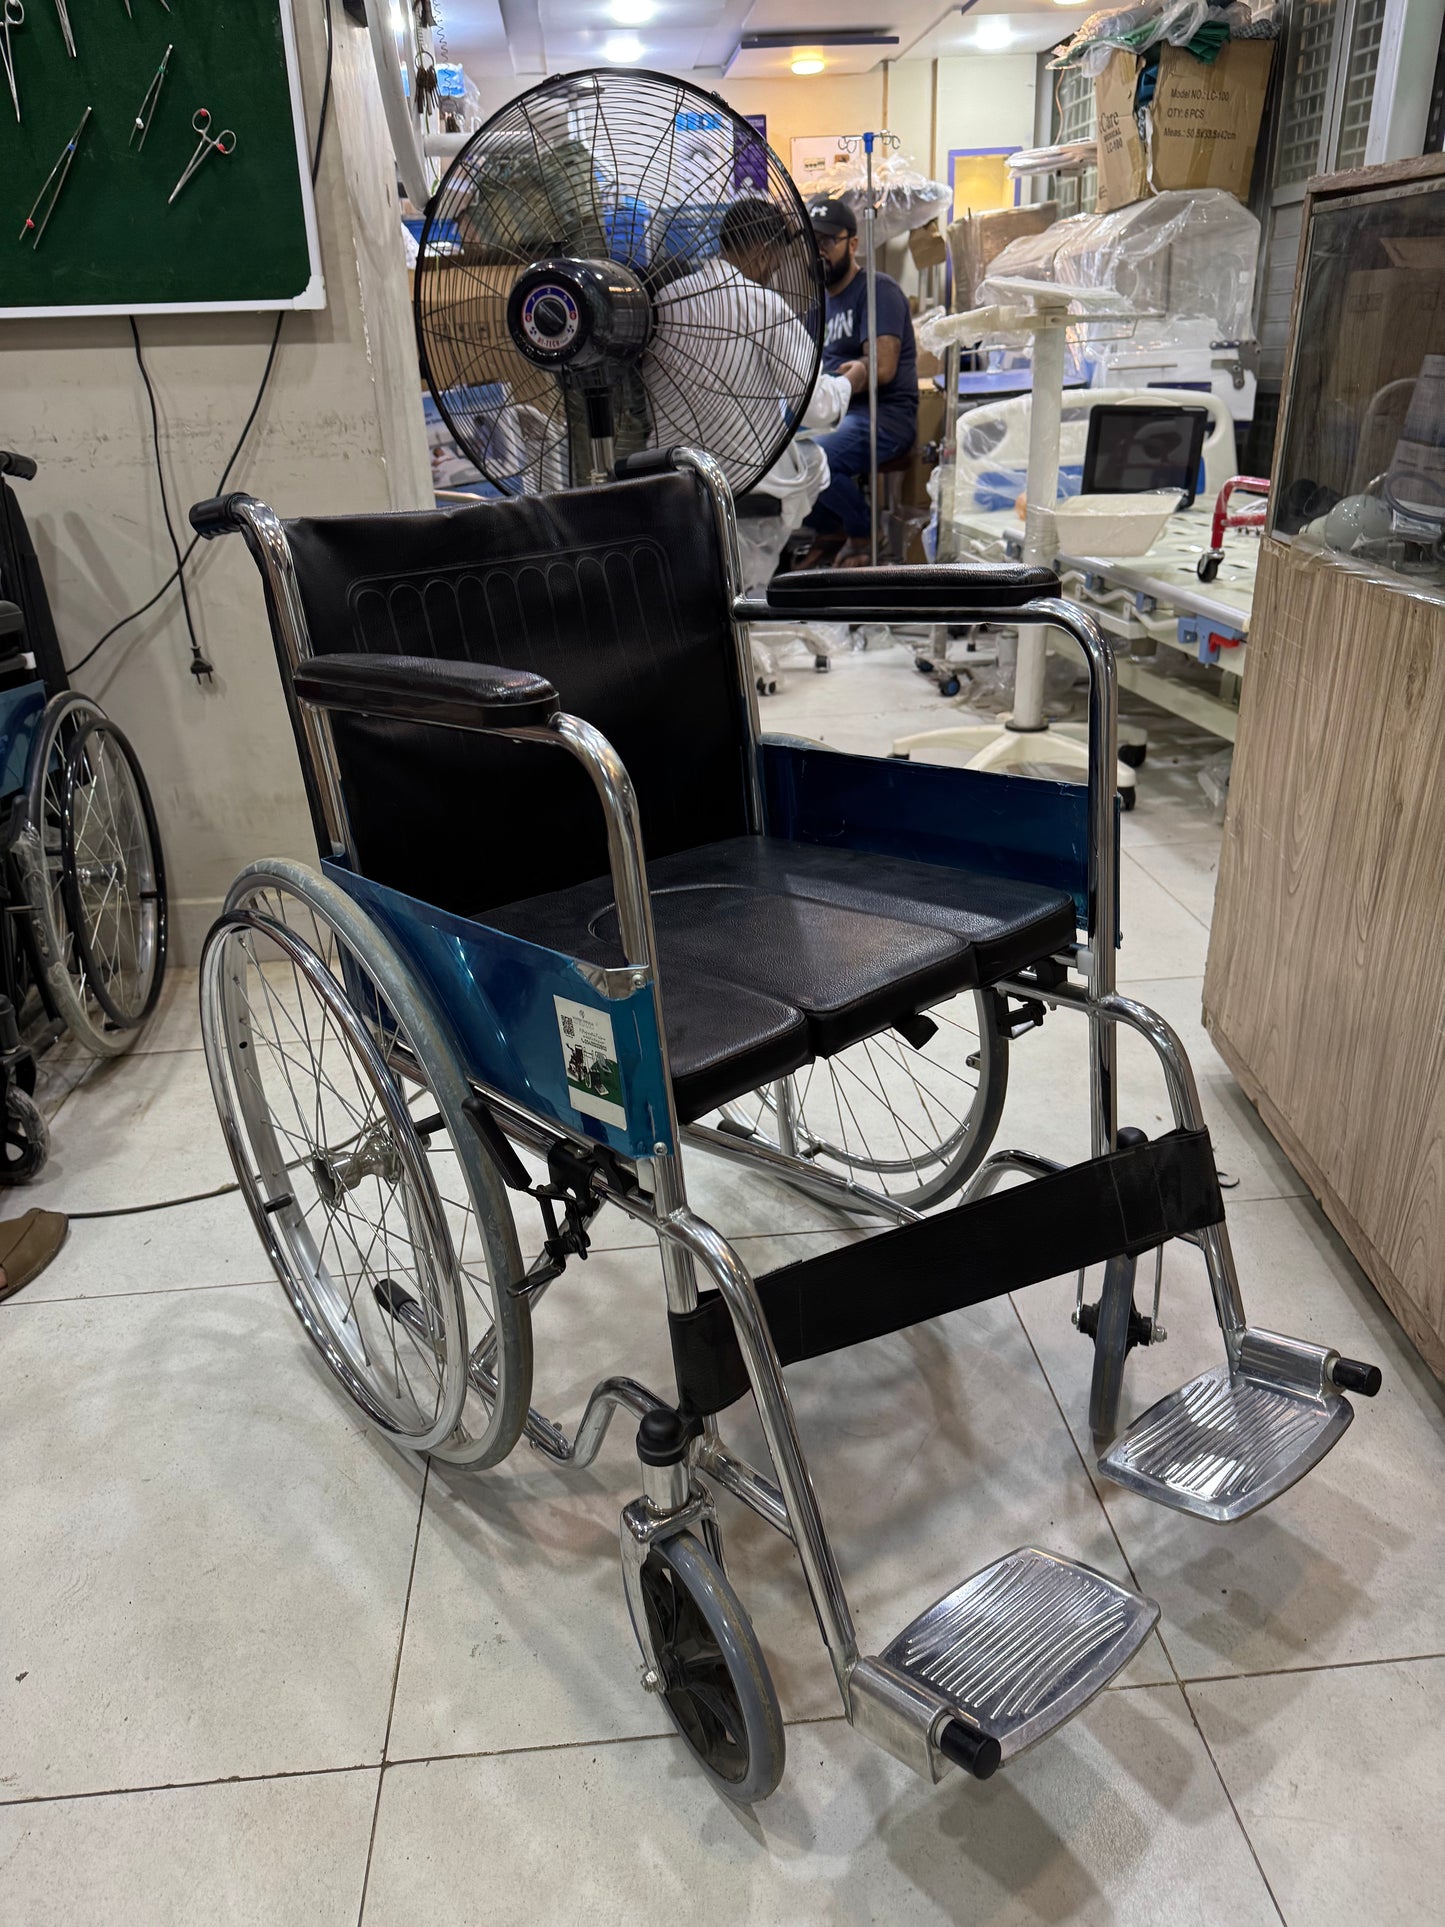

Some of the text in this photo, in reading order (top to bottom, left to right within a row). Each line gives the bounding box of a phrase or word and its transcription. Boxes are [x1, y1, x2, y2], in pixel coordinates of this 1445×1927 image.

[1171, 88, 1190, 98] Model
[1206, 90, 1230, 101] LC-100
[1166, 107, 1183, 118] QTY:
[1190, 108, 1205, 119] PCS
